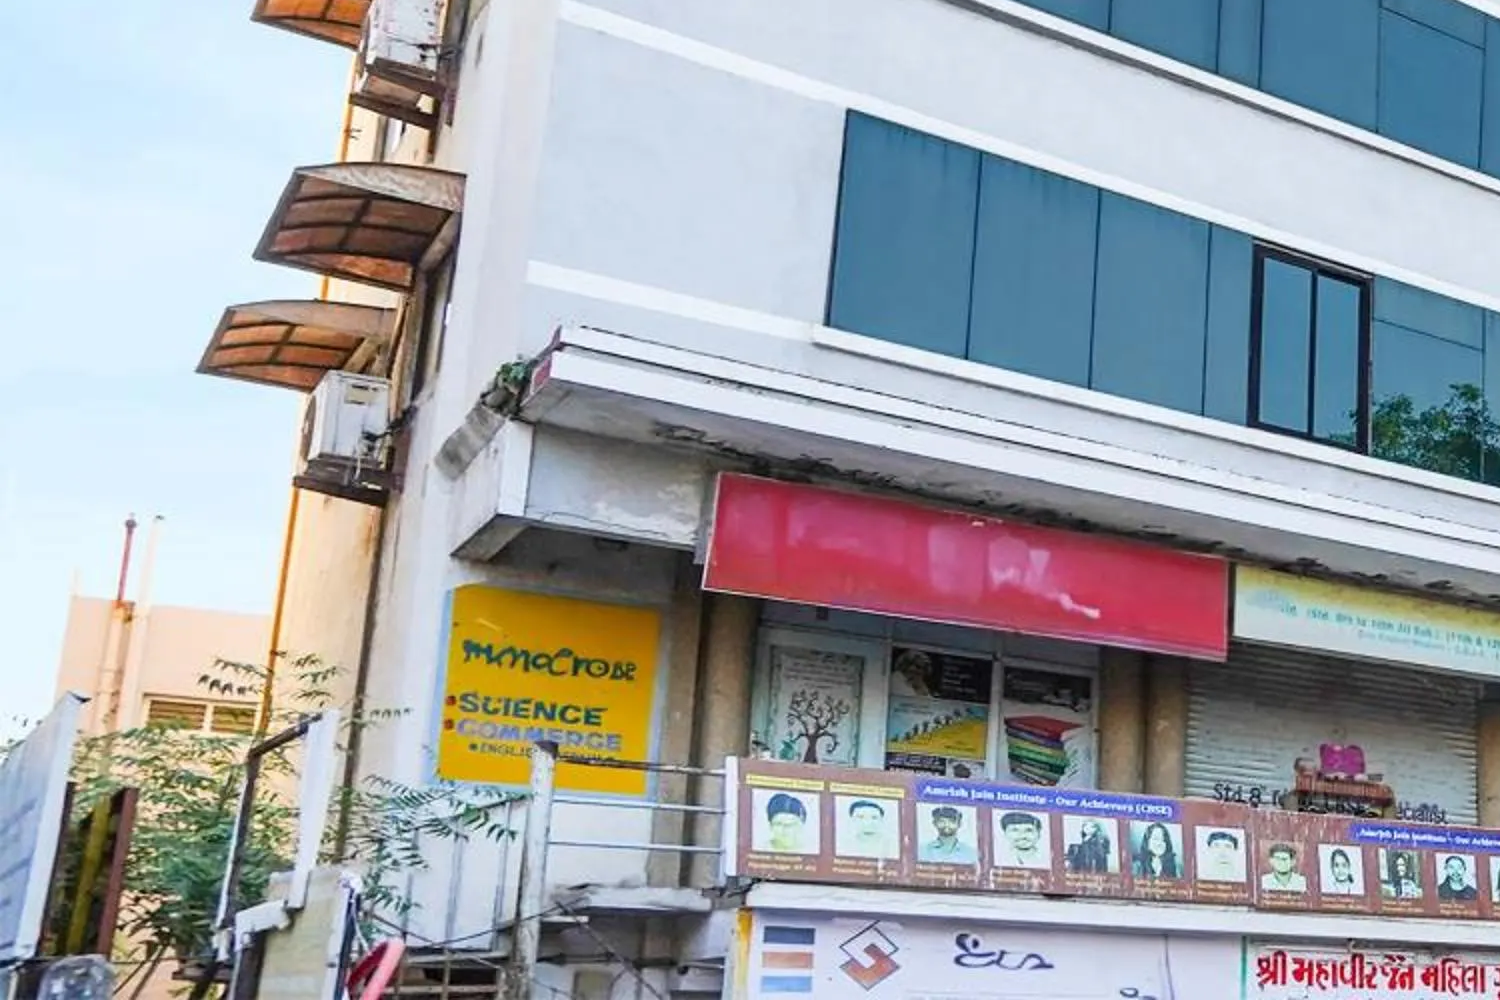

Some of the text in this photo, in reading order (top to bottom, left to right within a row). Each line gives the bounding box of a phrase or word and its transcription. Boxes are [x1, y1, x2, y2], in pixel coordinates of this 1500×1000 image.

[459, 692, 609, 727] SCIENCE
[456, 718, 622, 751] COMMERCE
[479, 742, 538, 759] ENGLIS
[923, 784, 969, 800] Amrish
[970, 787, 994, 802] Jain
[1055, 795, 1078, 808] Our
[1256, 950, 1288, 990] શ્રી
[1291, 952, 1378, 990] મહાવીર
[1420, 957, 1486, 996] મહિલા
